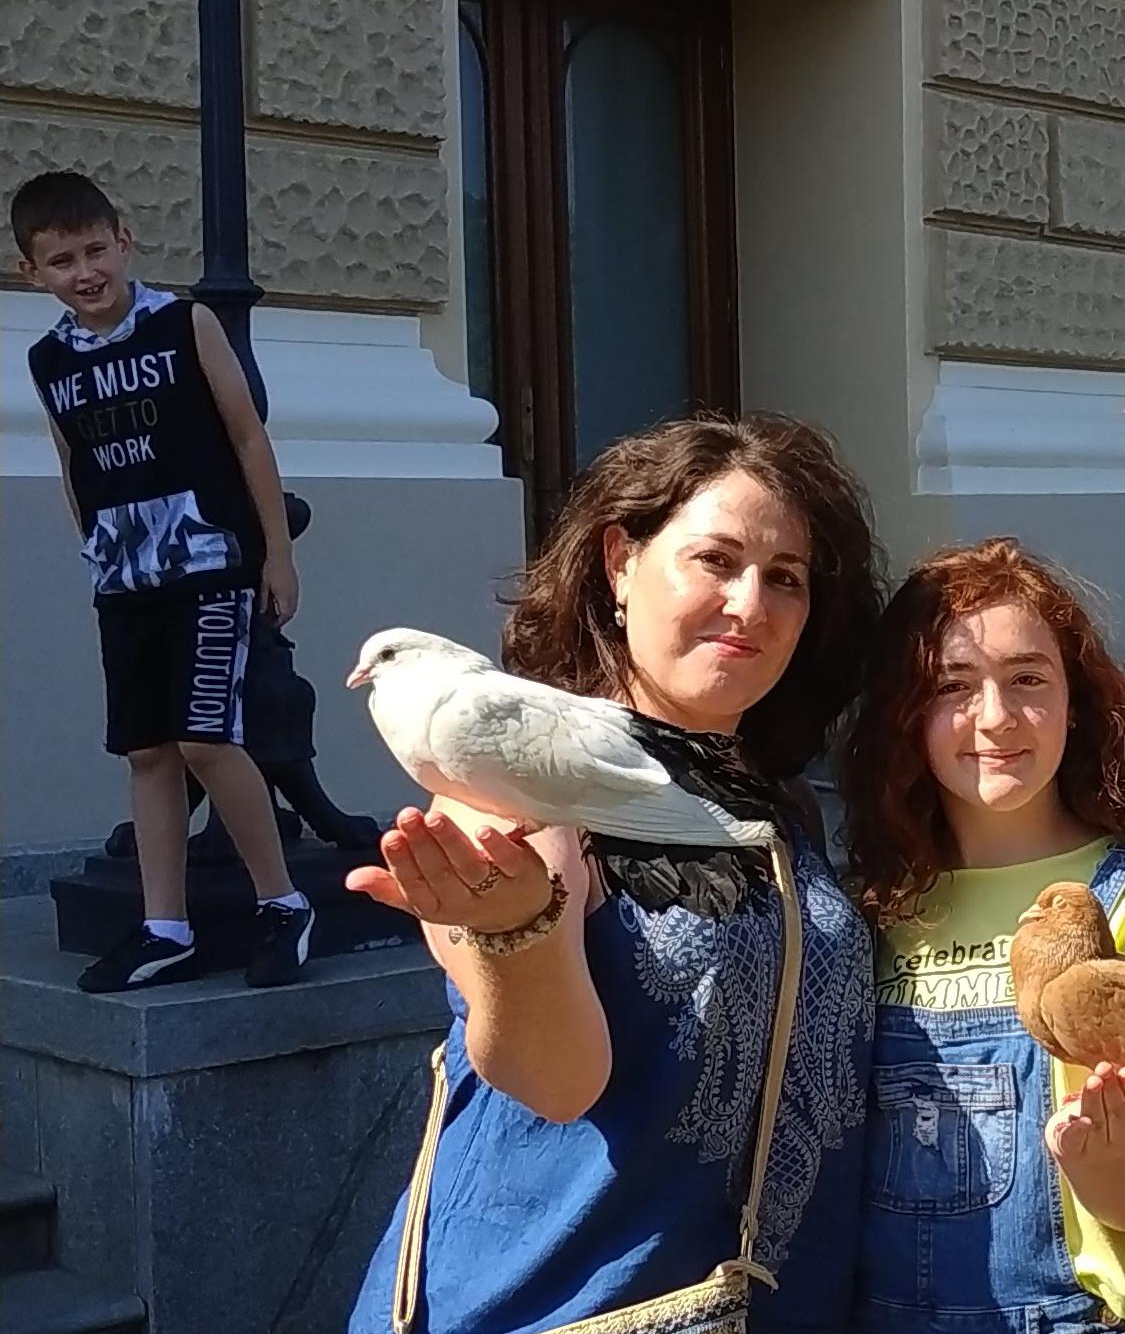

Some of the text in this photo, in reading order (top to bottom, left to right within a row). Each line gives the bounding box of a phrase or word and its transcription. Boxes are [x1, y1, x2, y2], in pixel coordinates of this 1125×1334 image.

[50, 350, 177, 414] WE MUST
[77, 398, 158, 440] GET TO
[92, 435, 156, 472] WORK
[893, 939, 1009, 973] celebrat
